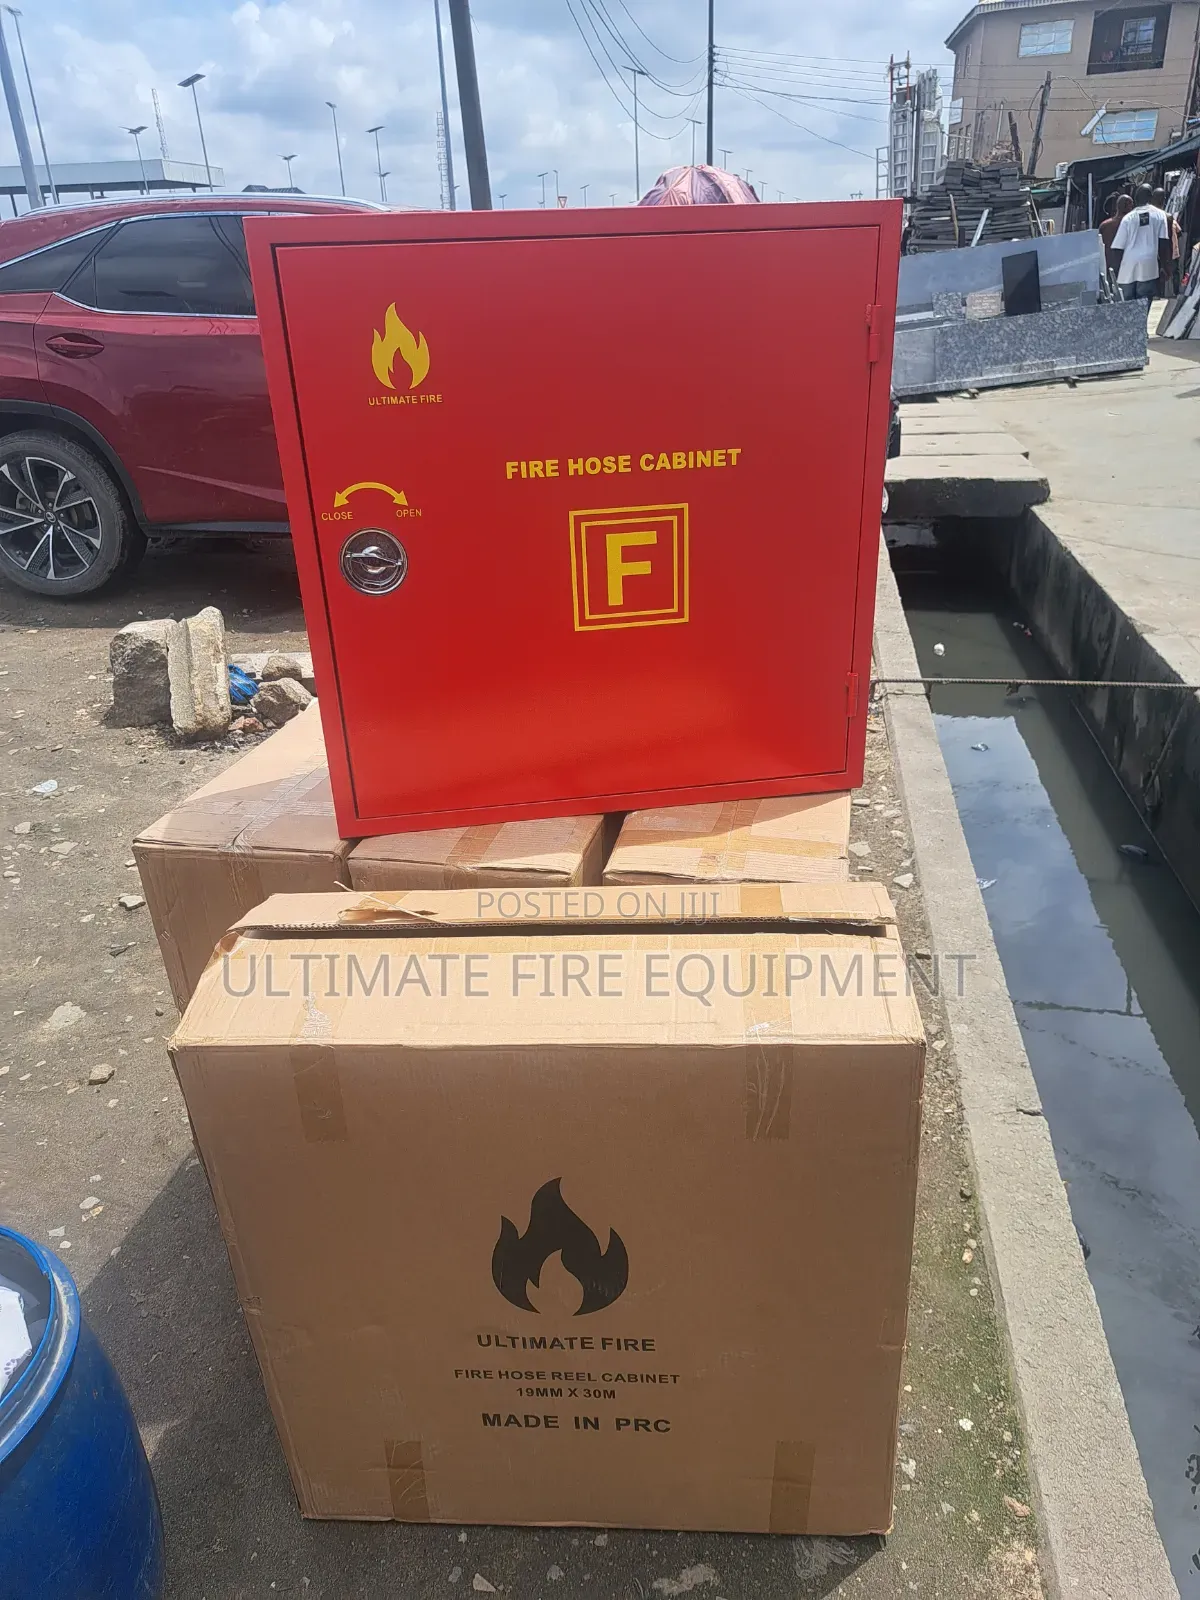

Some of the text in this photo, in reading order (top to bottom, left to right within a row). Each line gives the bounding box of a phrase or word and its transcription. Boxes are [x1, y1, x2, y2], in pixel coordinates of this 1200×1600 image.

[368, 394, 443, 406] ULTIMATE FIRE
[505, 448, 742, 479] FIRE HOSE CABINET
[321, 511, 354, 521] CLOSE
[396, 508, 422, 518] OPEN
[605, 531, 657, 607] F
[476, 1334, 656, 1353] ULTIMATE FIRE
[454, 1369, 681, 1385] FIRE HOSE REEL CABINET
[516, 1387, 617, 1400] 19MM X 30M
[481, 1412, 671, 1434] MADE IN PRC
